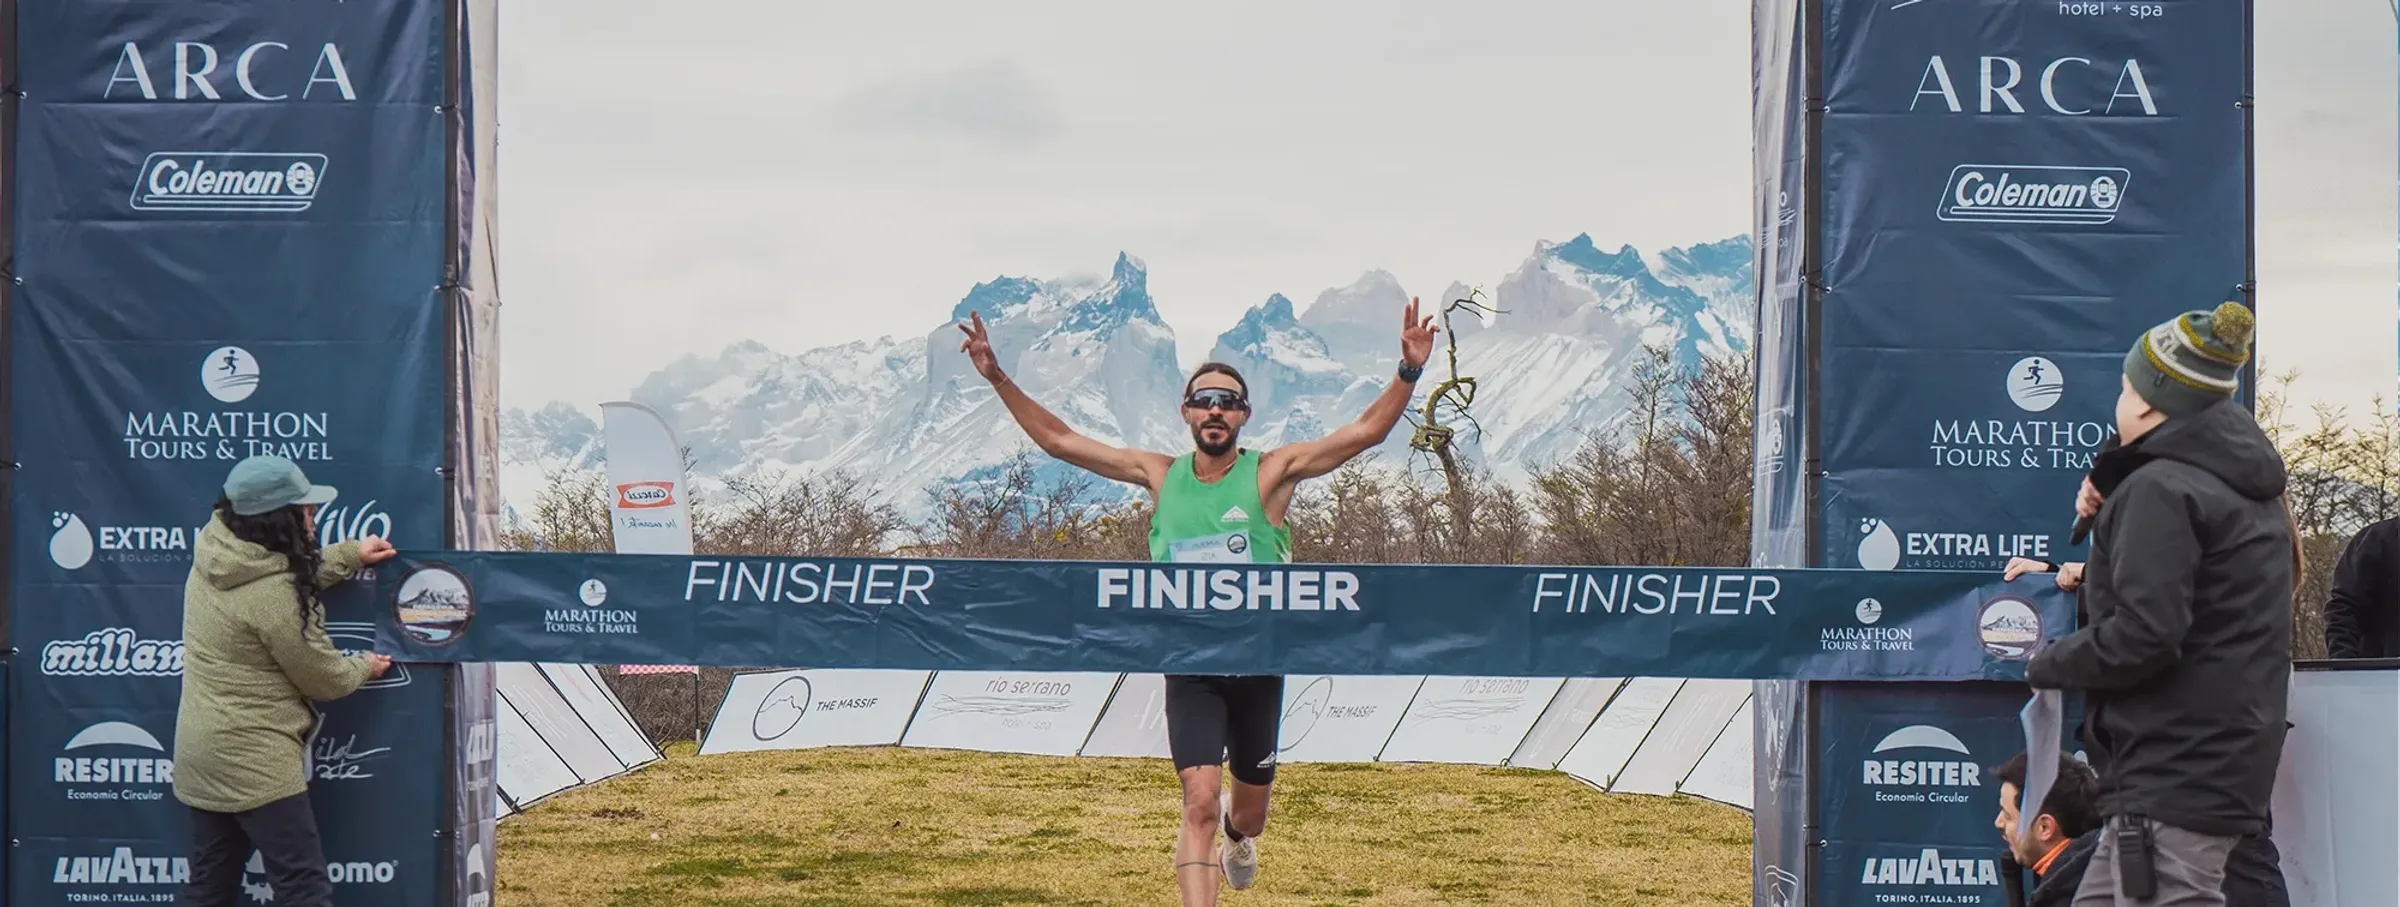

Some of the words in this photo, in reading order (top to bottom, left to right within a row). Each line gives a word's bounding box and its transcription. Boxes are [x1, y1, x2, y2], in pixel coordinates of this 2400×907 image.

[2058, 0, 2104, 16] hotel
[2130, 4, 2163, 19] spa
[104, 42, 356, 100] ARCA
[1910, 55, 2158, 116] ARCA
[149, 158, 283, 196] Coleman
[1955, 171, 2087, 208] Coleman
[126, 411, 328, 438] MARATHON
[124, 438, 208, 460] TOURS
[216, 439, 236, 460] &
[1930, 446, 2011, 467] TOURS
[2020, 448, 2041, 468] &
[100, 526, 187, 550] EXTRA
[1906, 532, 1990, 556] EXTRA
[1998, 534, 2050, 557] LIFE
[1906, 560, 1920, 568] LA
[685, 560, 935, 605] FINISHER
[1098, 568, 1360, 611] FINISHER
[1532, 573, 1781, 615] FINISHER
[544, 609, 637, 623] MARATHON
[544, 621, 582, 632] TOURS
[585, 622, 595, 633] &
[598, 622, 639, 634] TRAVEL
[1821, 627, 1912, 640] MARATHON
[1820, 640, 1857, 650] TOURS
[1861, 640, 1871, 650] &
[1873, 640, 1915, 651] TRAVEL
[1010, 680, 1072, 696] serrano
[816, 700, 838, 712] THE
[837, 697, 878, 710] MASSIF
[1327, 706, 1346, 718] THE
[55, 757, 174, 784] RESITER
[1863, 760, 1981, 786] RESITER
[121, 789, 163, 800] Circular
[1928, 792, 1969, 803] Circular
[53, 847, 192, 884] LAVAZZA
[327, 861, 394, 883] omo
[1862, 849, 1999, 885] LAVAZZA
